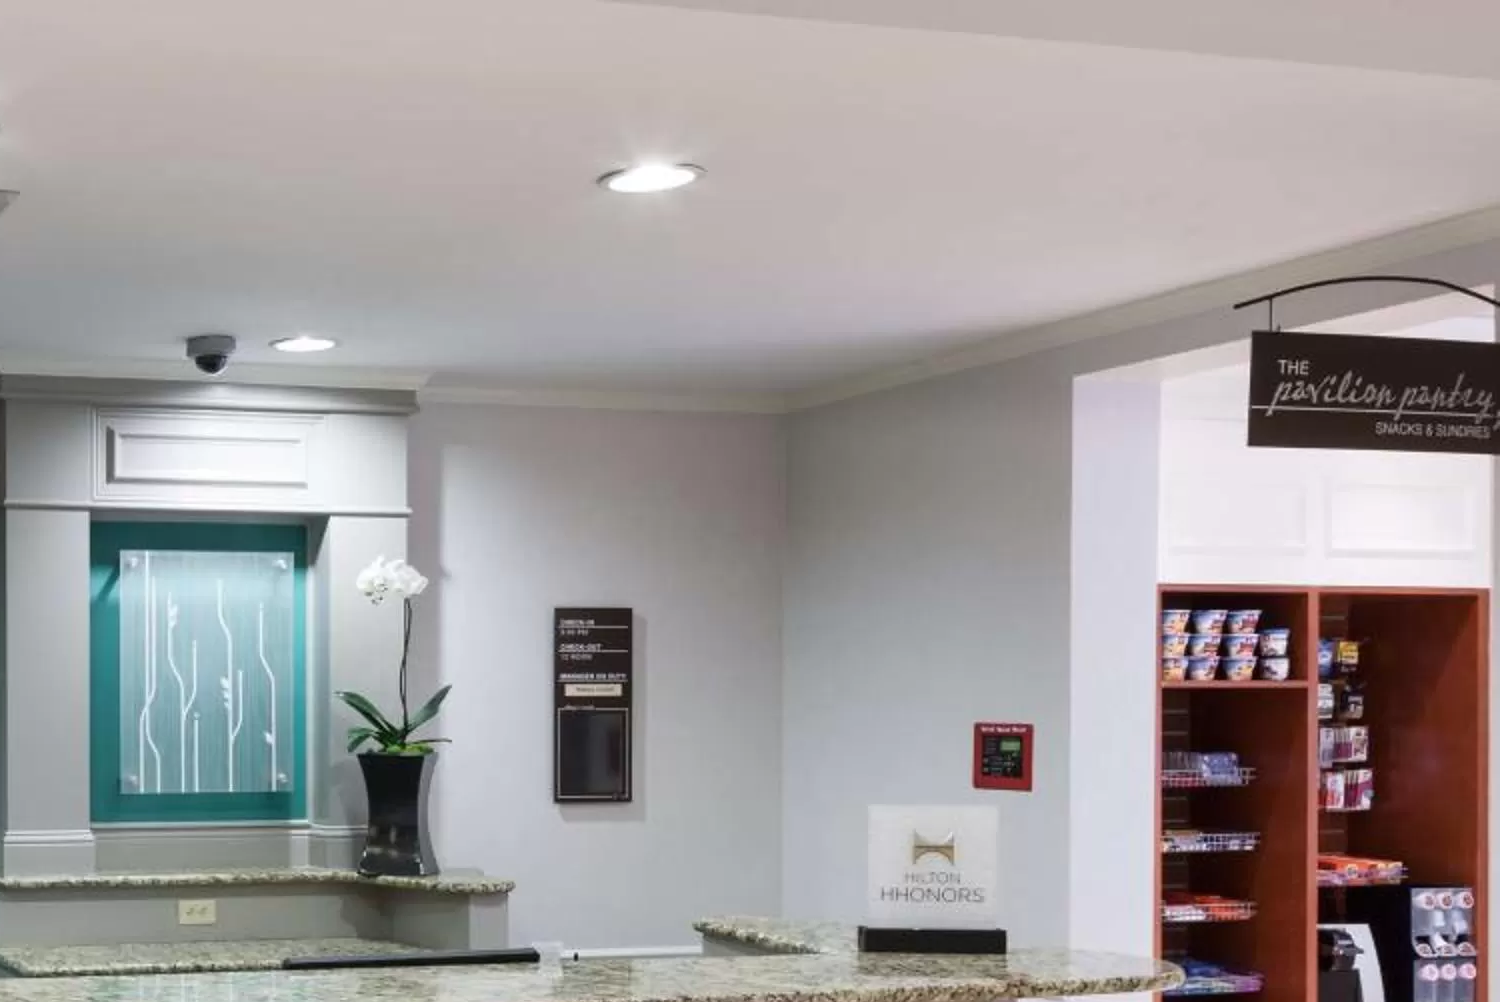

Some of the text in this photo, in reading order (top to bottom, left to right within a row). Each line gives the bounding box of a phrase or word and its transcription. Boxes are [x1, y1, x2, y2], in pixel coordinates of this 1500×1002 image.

[1277, 359, 1310, 376] THE
[1265, 370, 1496, 425] pavilion pantry
[1375, 421, 1491, 439] SNACKS & SUNDRIES
[904, 871, 961, 884] HILTON
[881, 887, 985, 903] HHONORS
